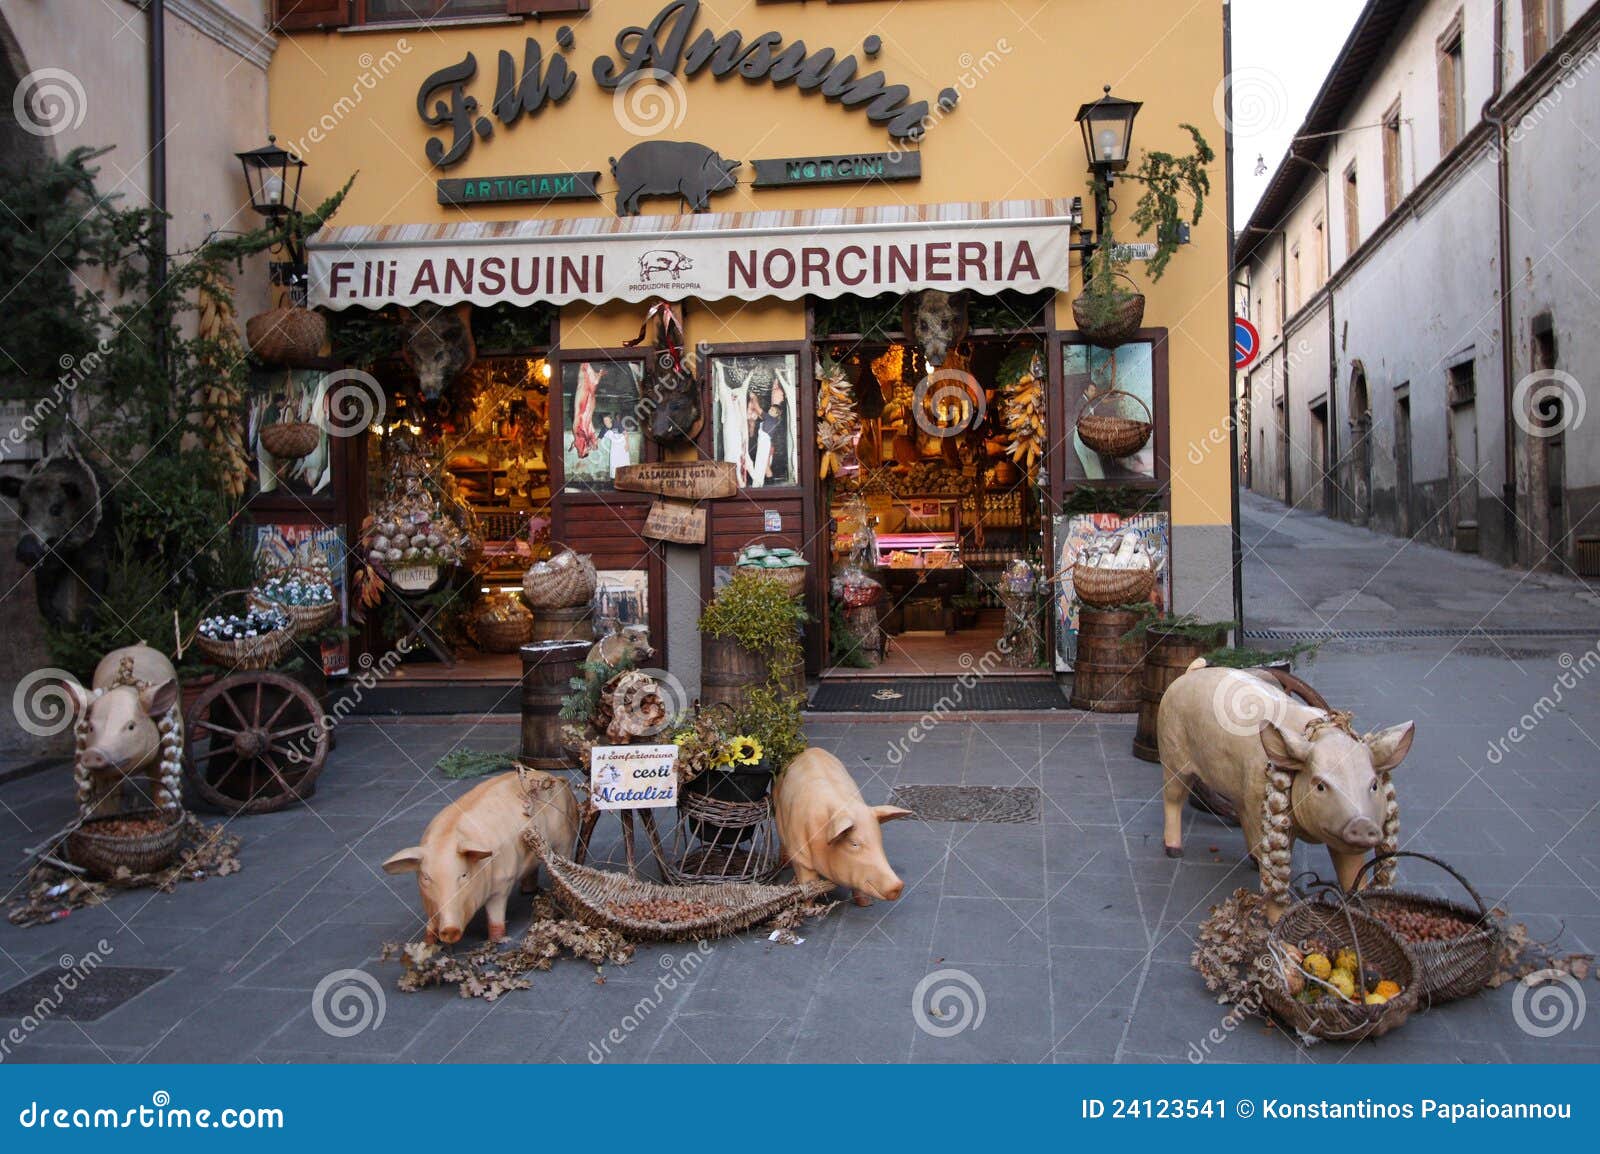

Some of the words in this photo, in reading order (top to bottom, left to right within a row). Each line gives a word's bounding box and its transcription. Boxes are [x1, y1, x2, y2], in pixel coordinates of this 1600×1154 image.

[592, 0, 959, 138] Ansuini
[786, 157, 884, 179] NORCINI
[464, 176, 576, 198] ARTIGIANI
[728, 240, 1040, 289] NORCINERIA
[329, 260, 397, 298] F.lli
[410, 255, 604, 296] ANSUINI
[629, 283, 671, 292] PRODUZIONE
[671, 282, 701, 290] PROPRIA
[633, 765, 670, 779] cesti
[595, 786, 674, 803] Natalizi
